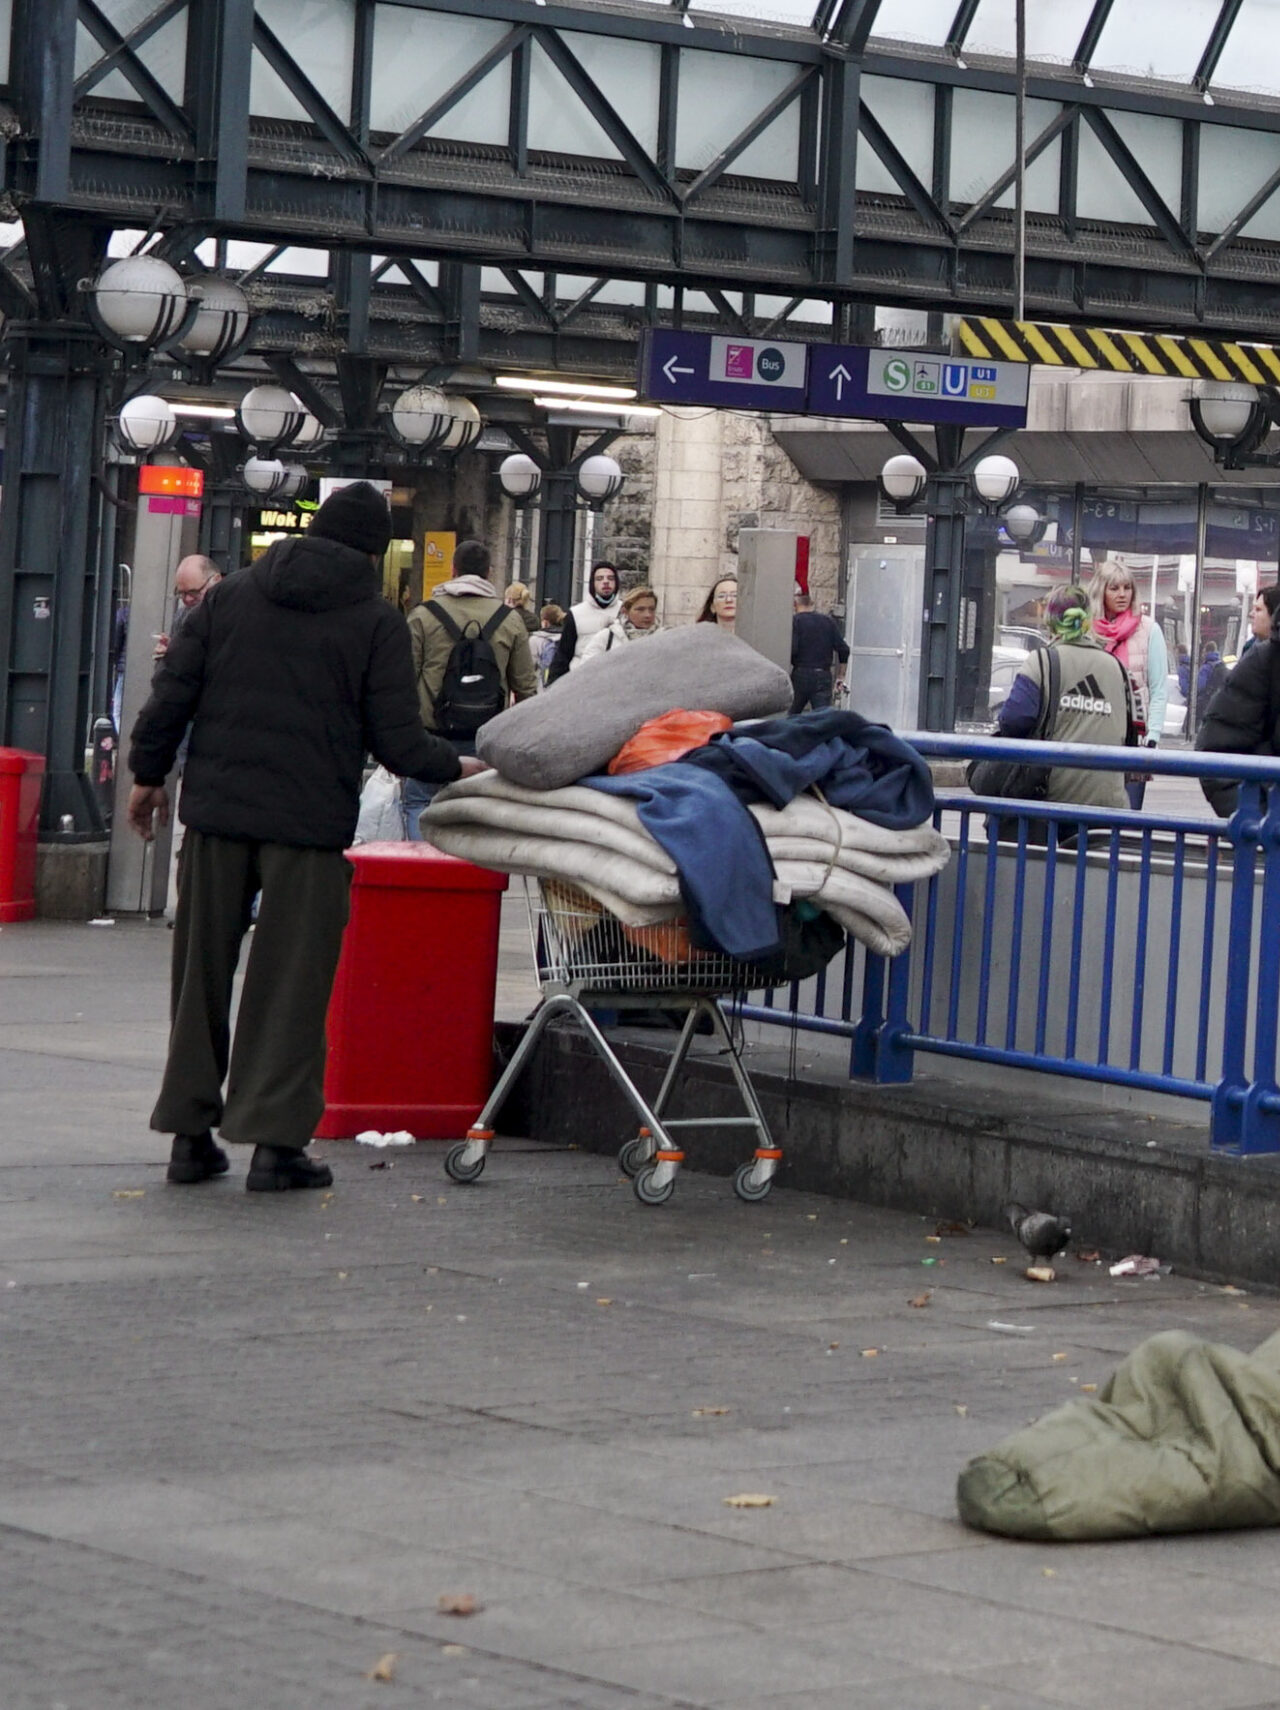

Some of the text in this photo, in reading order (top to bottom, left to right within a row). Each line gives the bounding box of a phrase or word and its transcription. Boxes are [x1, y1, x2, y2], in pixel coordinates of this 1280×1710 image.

[761, 358, 780, 371] Bus
[977, 368, 991, 379] U1
[887, 361, 906, 390] S
[945, 366, 965, 394] U
[261, 511, 297, 528] Wok
[1060, 695, 1112, 714] adidas
